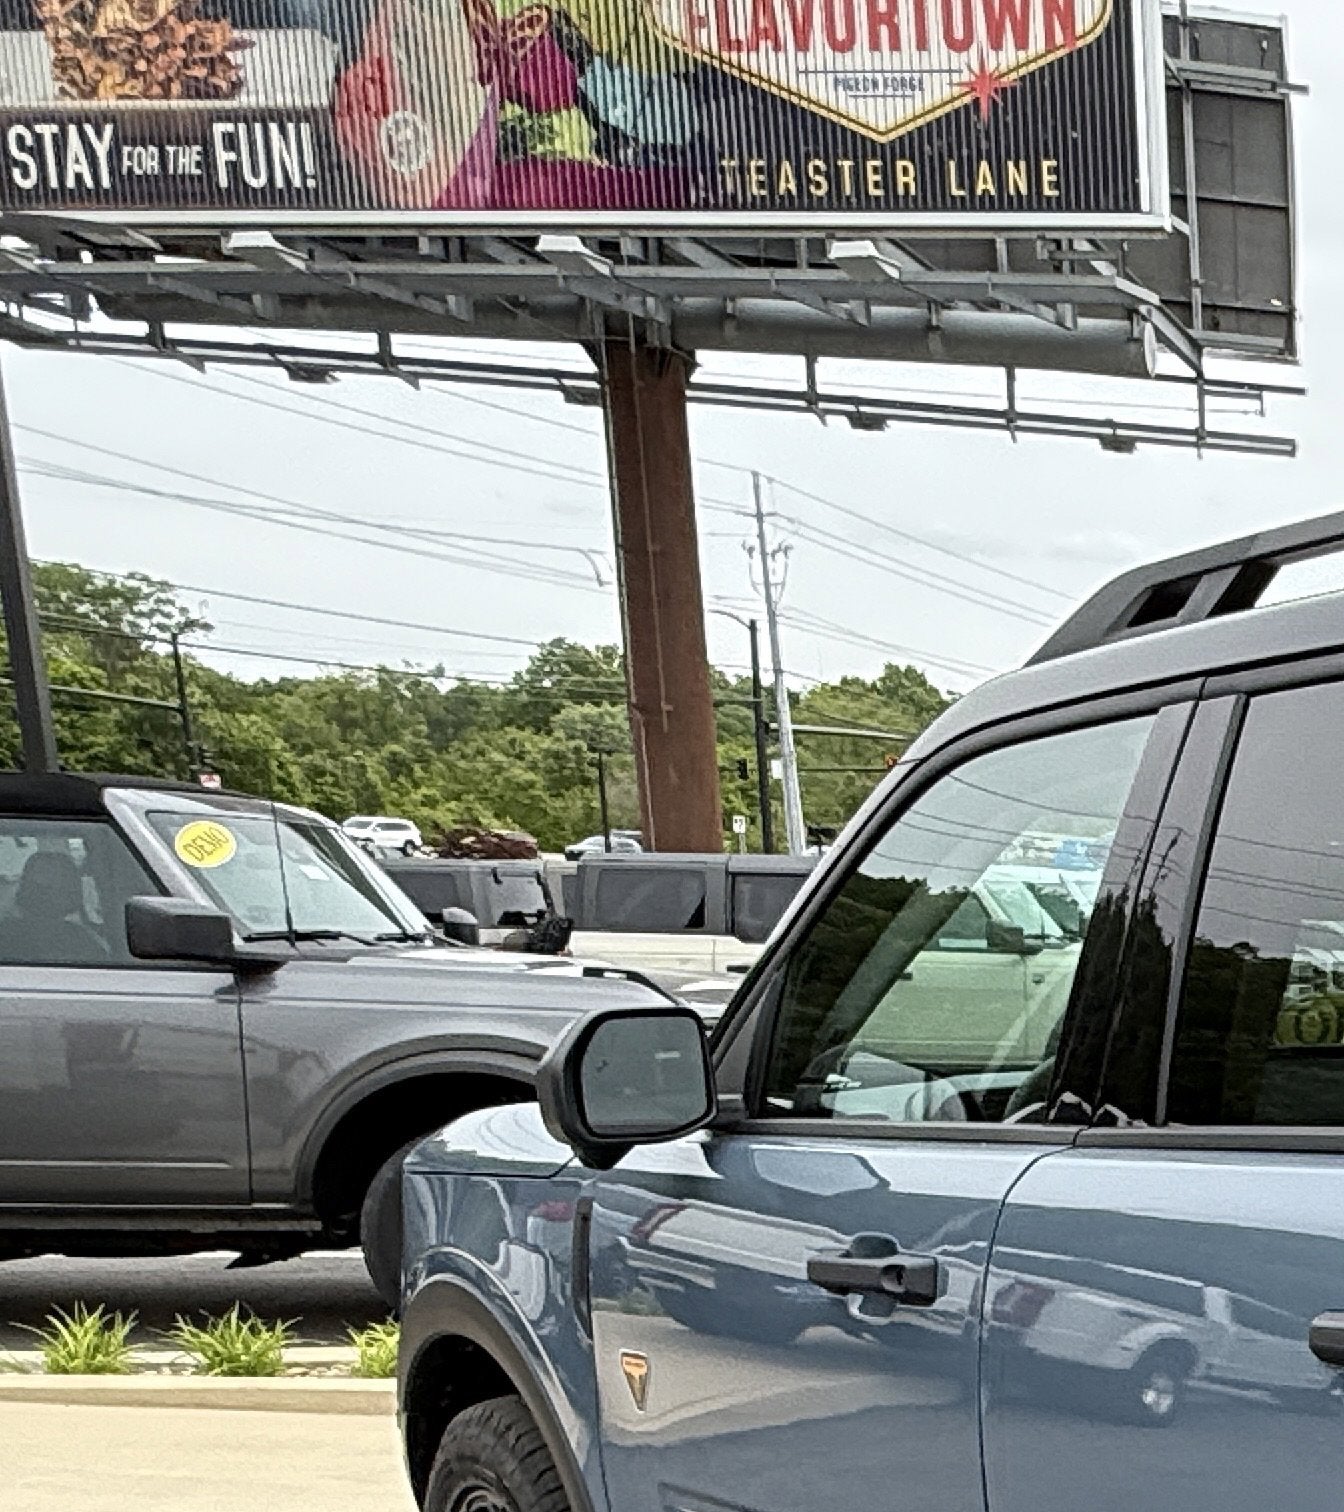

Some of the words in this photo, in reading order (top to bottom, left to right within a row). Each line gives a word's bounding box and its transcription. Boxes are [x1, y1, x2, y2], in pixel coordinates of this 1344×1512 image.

[8, 122, 114, 189] STAY
[122, 145, 159, 175] FOR
[165, 145, 202, 175] THE
[212, 122, 316, 189] FUN!
[721, 159, 917, 197] TEASTER
[949, 159, 1060, 197] LANE
[182, 826, 230, 862] DEMO
